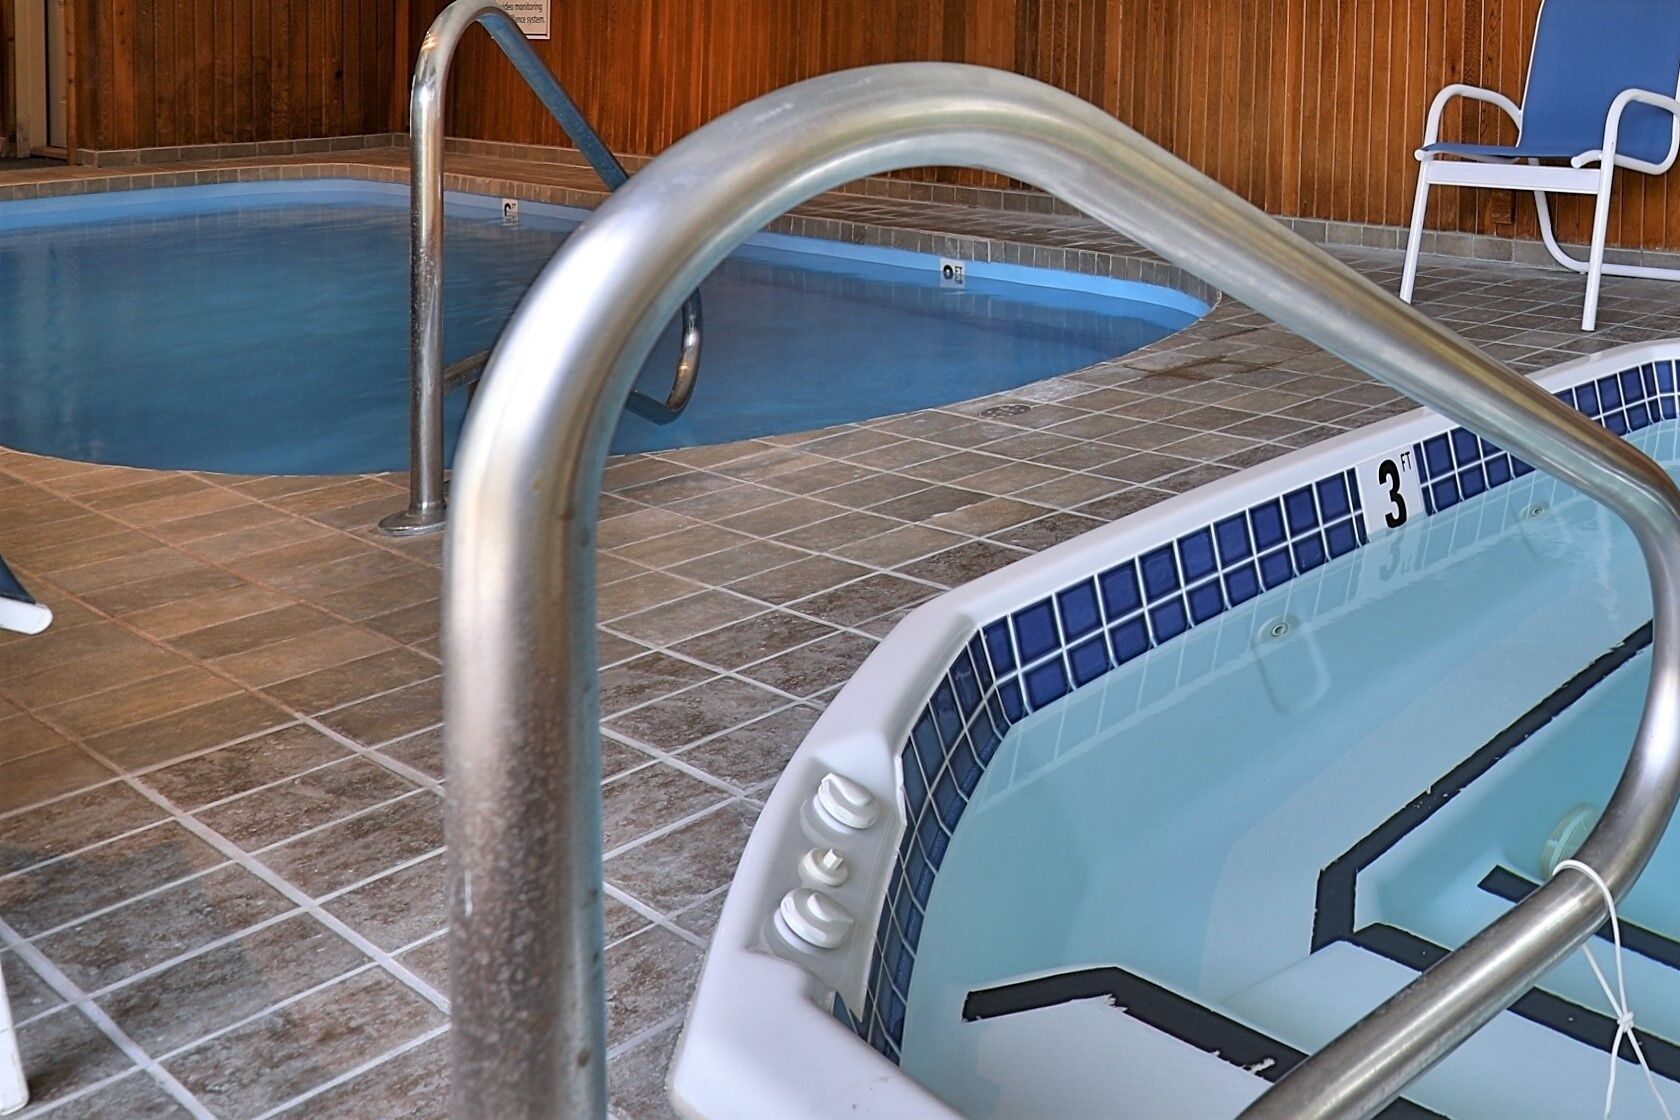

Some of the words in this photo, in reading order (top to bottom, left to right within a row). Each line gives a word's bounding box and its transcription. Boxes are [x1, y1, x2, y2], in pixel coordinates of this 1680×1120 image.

[515, 2, 543, 12] monitoring
[1378, 459, 1408, 529] 3
[1400, 451, 1412, 473] FT
